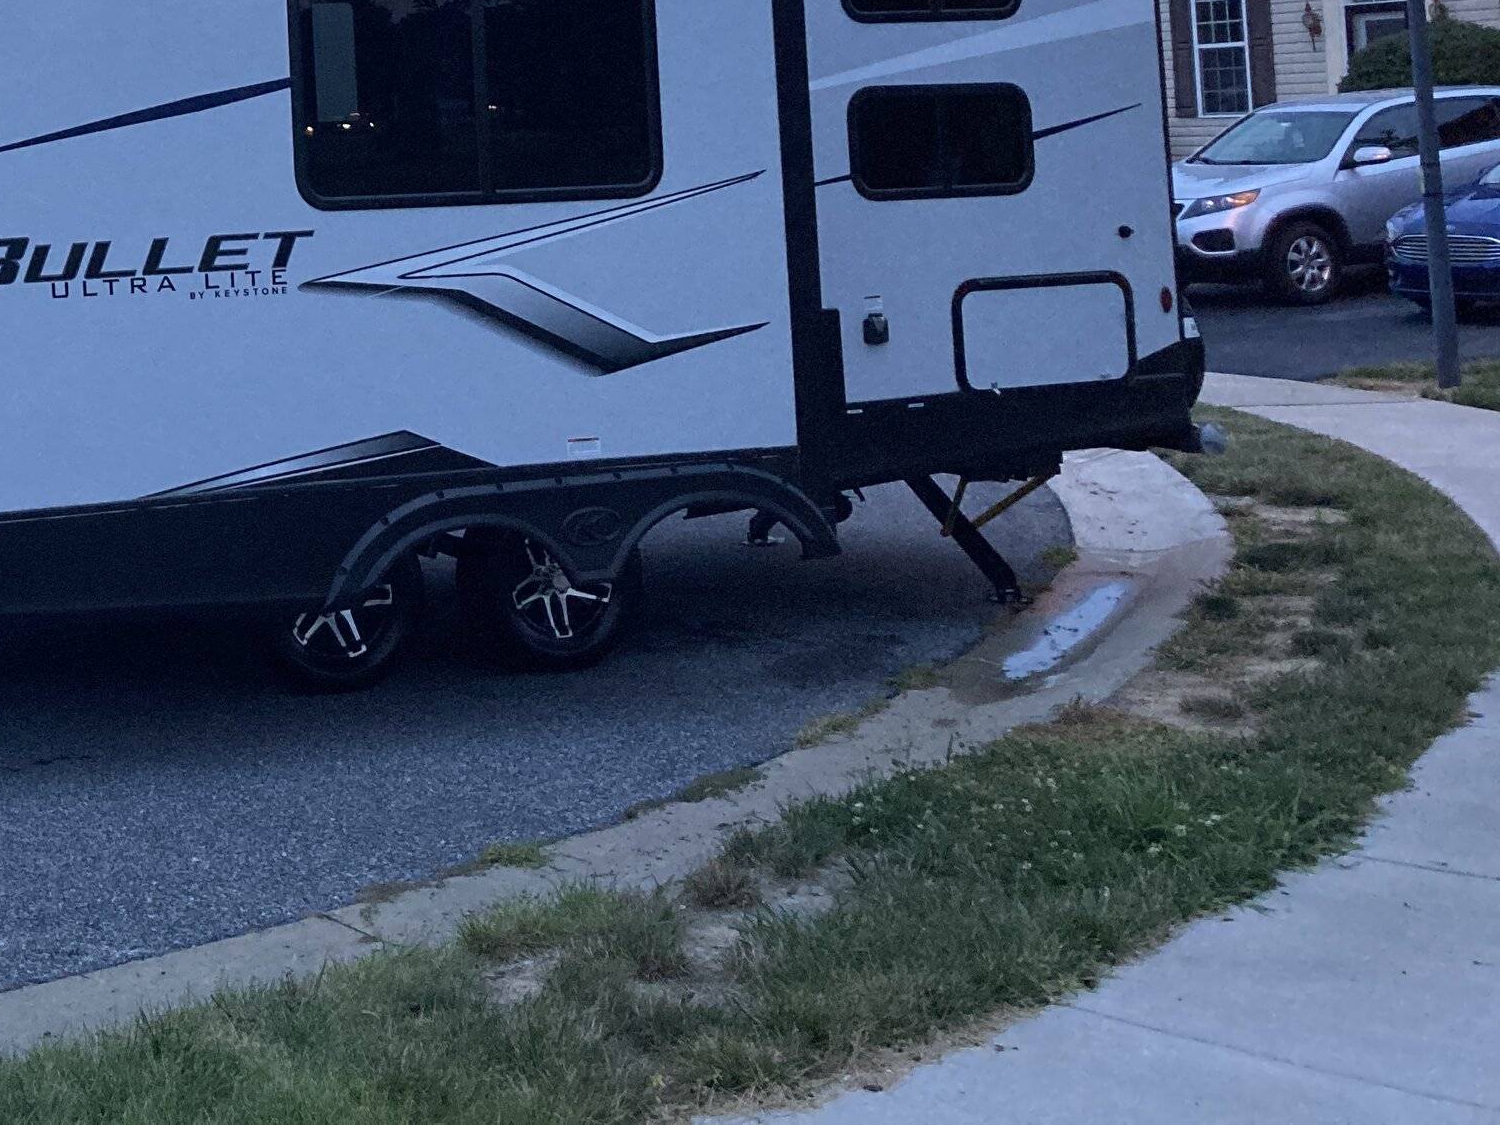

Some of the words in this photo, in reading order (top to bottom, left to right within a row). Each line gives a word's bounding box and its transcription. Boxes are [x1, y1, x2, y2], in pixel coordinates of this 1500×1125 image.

[51, 275, 177, 299] ULTRA
[204, 269, 288, 290] LITE
[189, 291, 205, 300] BY
[214, 286, 288, 299] KEYSTONE
